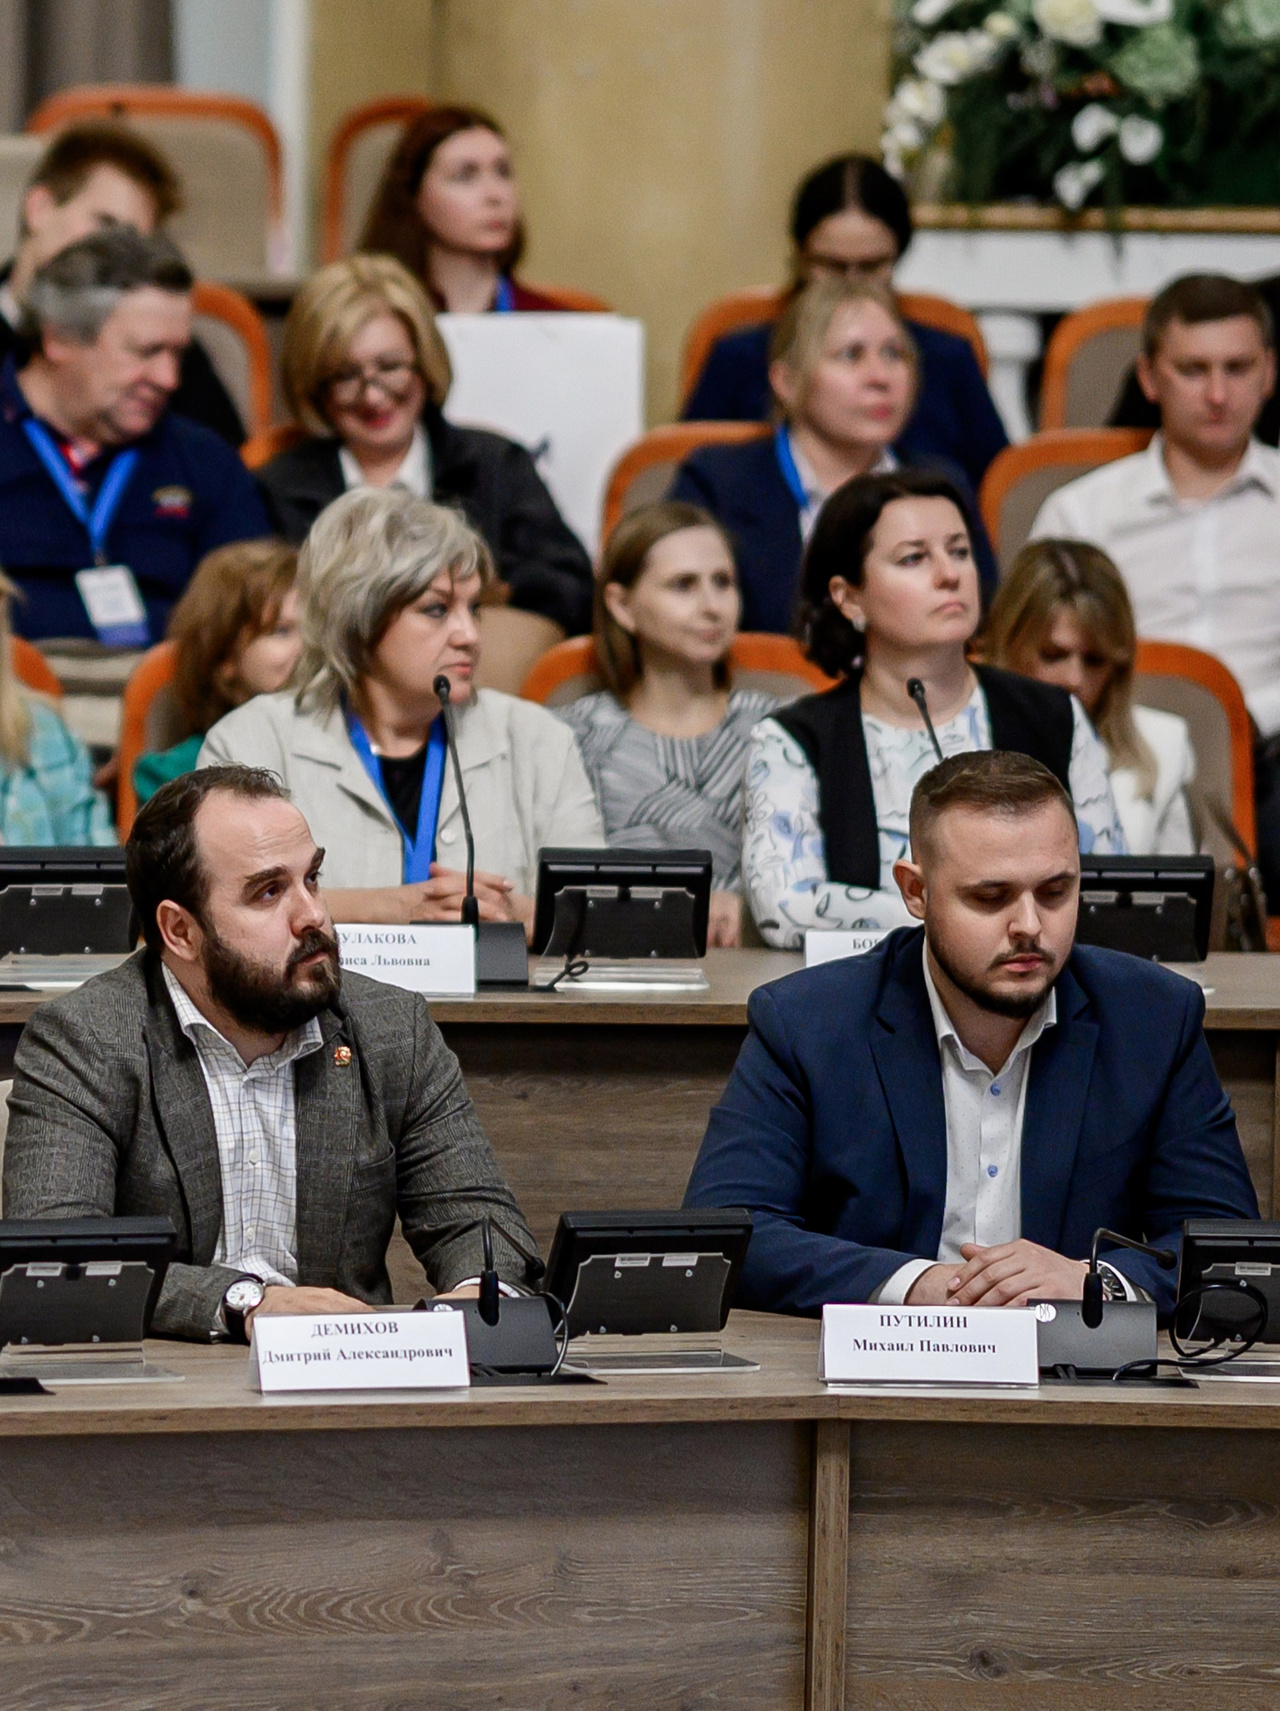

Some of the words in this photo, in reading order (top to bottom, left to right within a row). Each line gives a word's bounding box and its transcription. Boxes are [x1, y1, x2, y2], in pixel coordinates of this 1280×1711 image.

[338, 932, 417, 945] УЛАКОВА
[852, 937, 881, 950] БО
[371, 954, 430, 967] Львовна
[879, 1314, 968, 1328] ПУТИЛИН
[311, 1321, 399, 1337] ДЕМИХОВ
[852, 1338, 915, 1352] Михаил
[919, 1340, 997, 1354] Павлович
[262, 1348, 332, 1365] Дмитрий
[336, 1347, 454, 1362] Александрович
